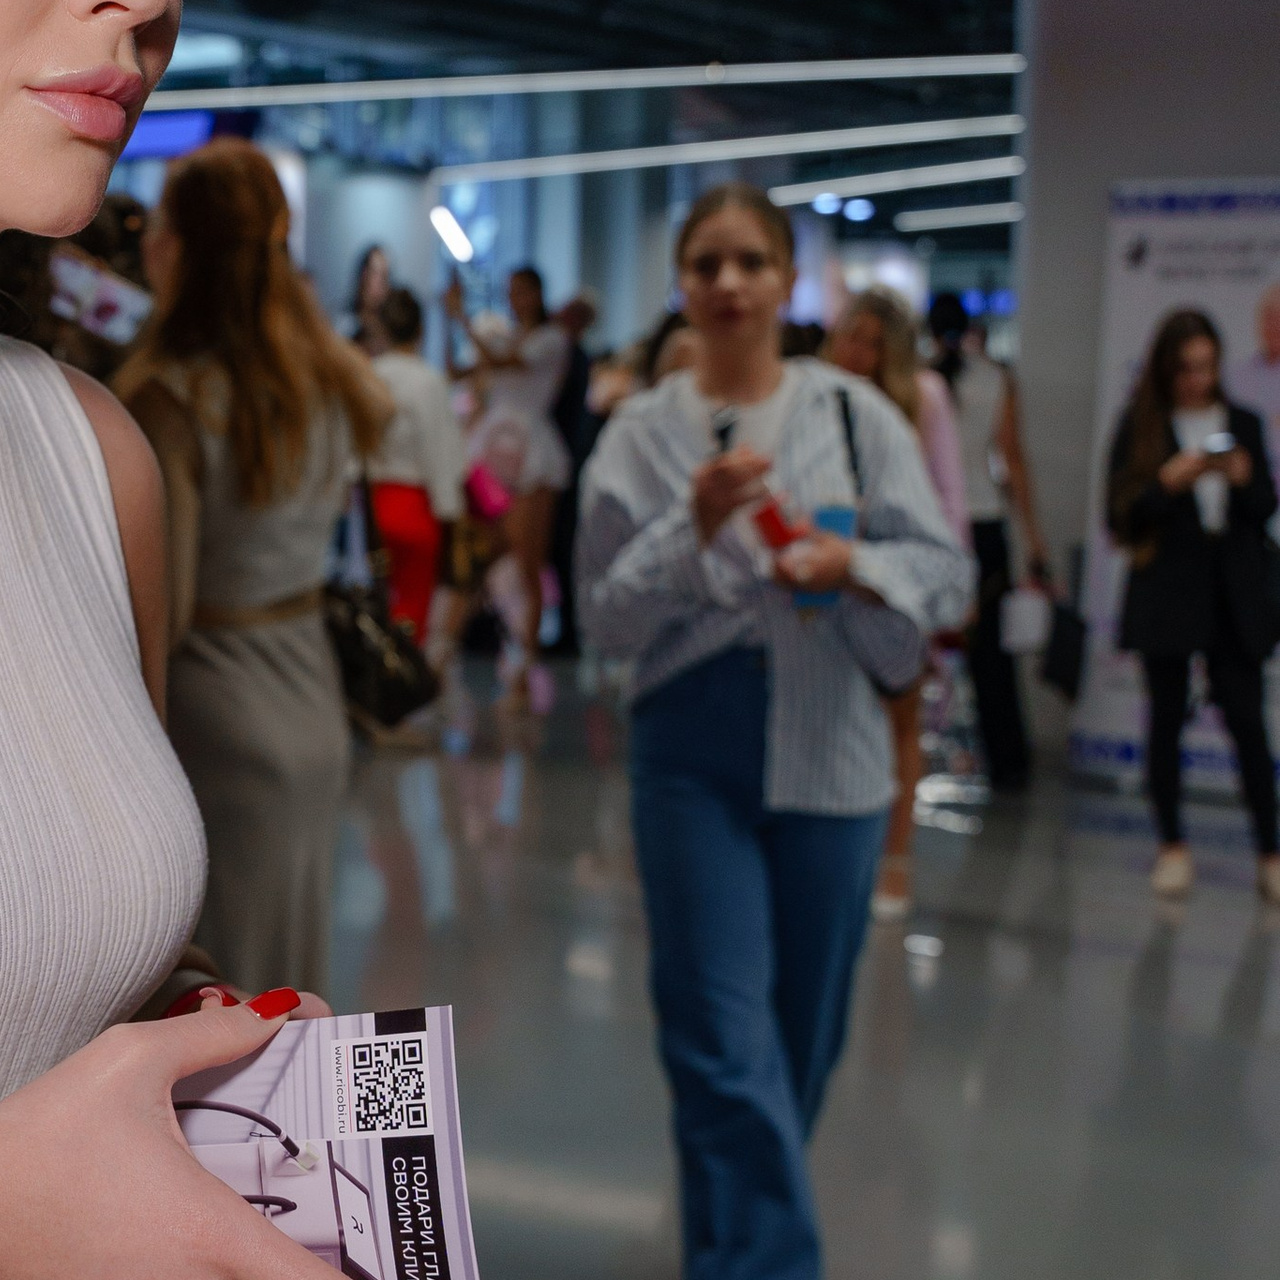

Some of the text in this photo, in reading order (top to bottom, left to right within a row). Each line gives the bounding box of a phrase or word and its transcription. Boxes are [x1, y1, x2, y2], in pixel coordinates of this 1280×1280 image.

[334, 1046, 346, 1134] www.ricobi.ru
[391, 1156, 415, 1235] СВОИМ
[411, 1156, 435, 1245] ПОДАРИ
